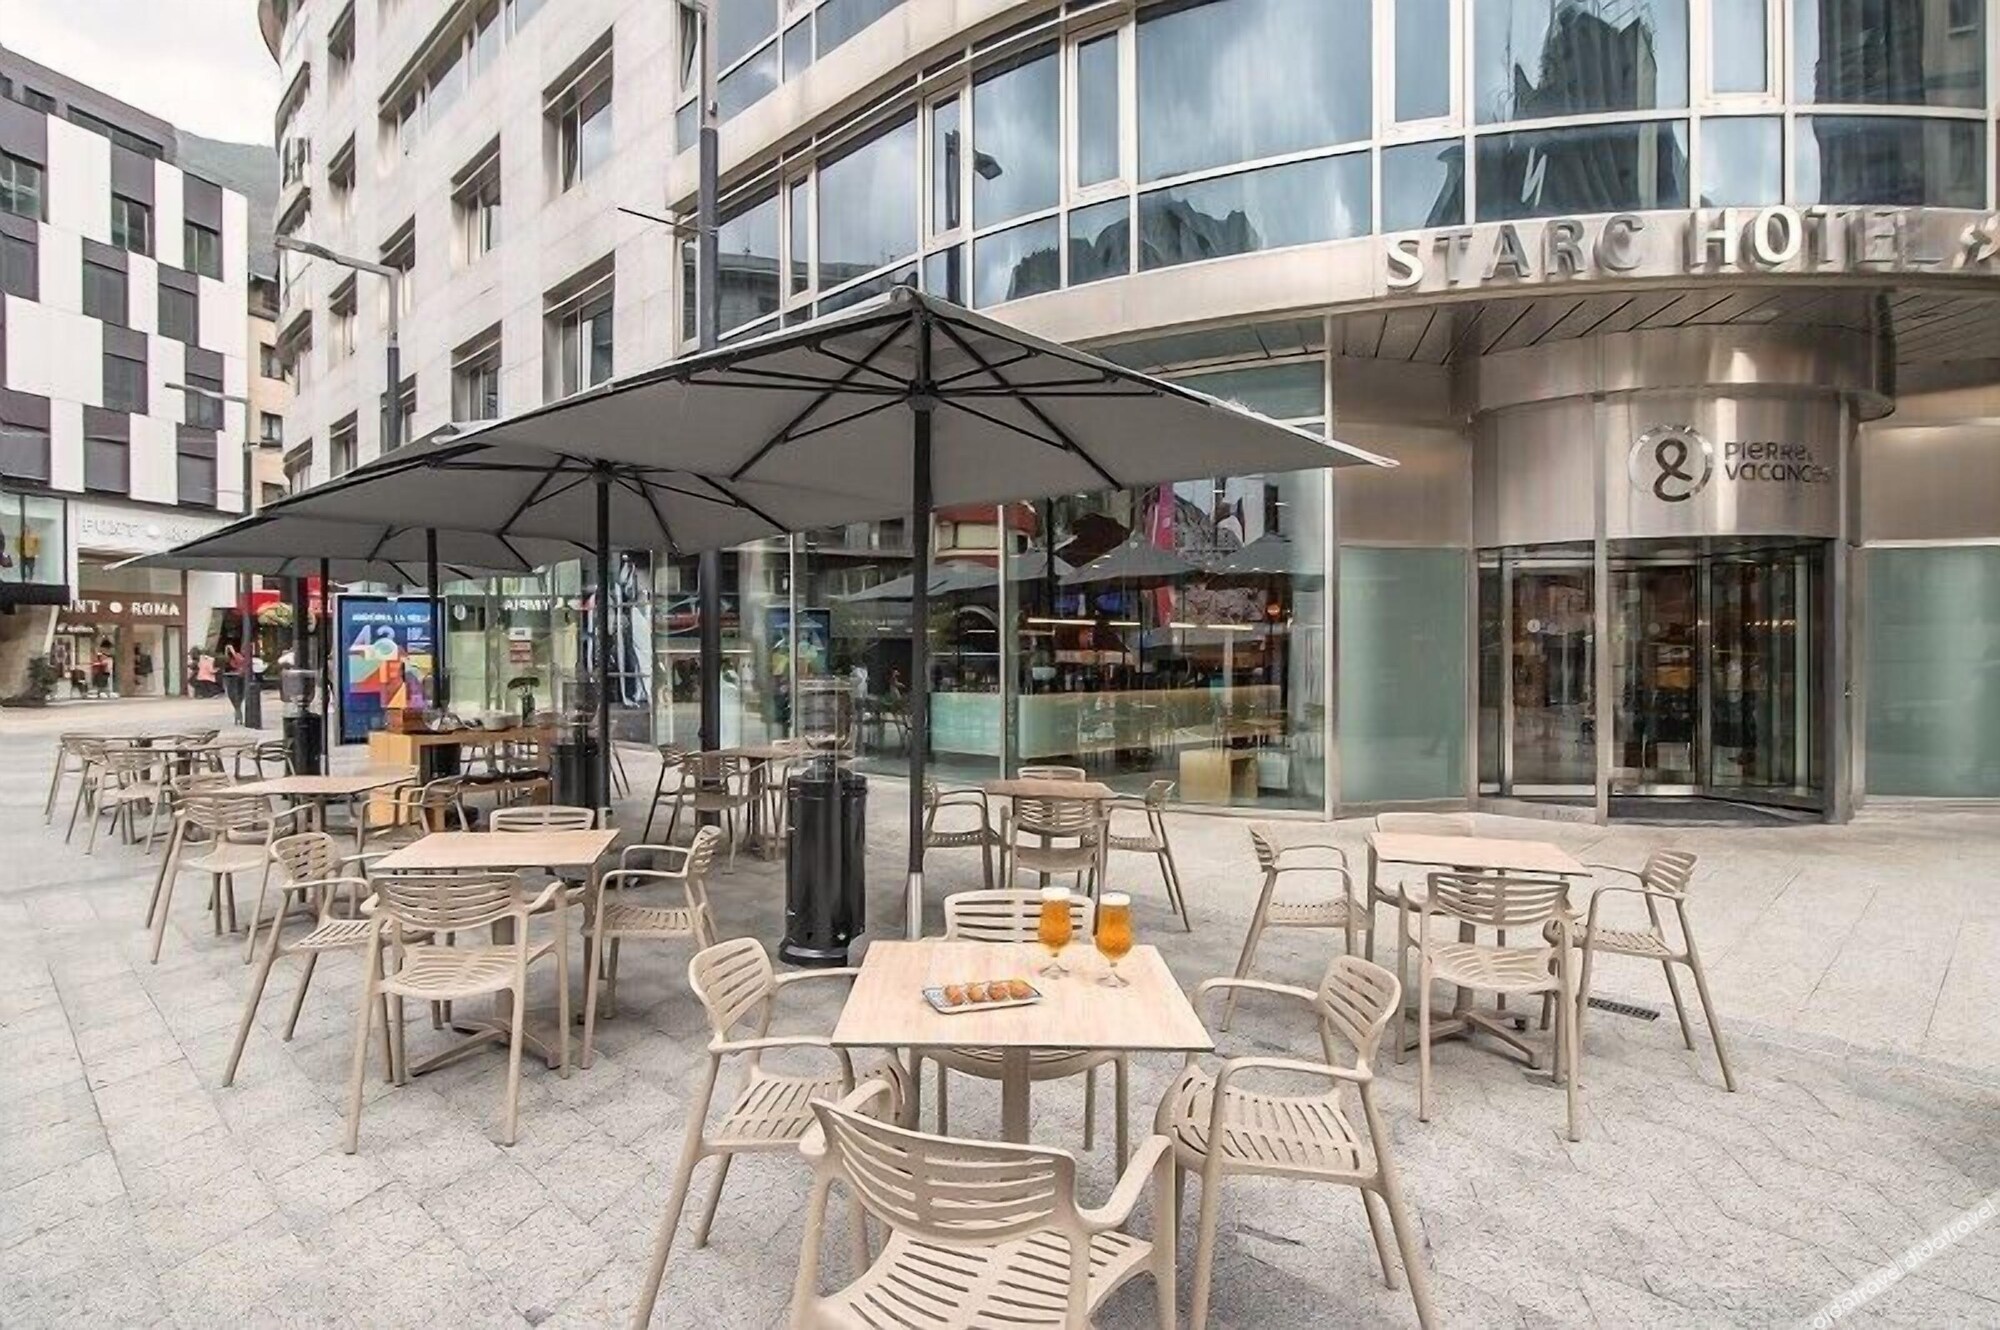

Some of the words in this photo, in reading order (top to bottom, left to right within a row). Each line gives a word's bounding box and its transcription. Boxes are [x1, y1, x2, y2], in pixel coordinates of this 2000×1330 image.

[1386, 213, 1643, 288] STARC
[1686, 204, 1944, 267] HOTEL
[131, 602, 180, 616] ROMA
